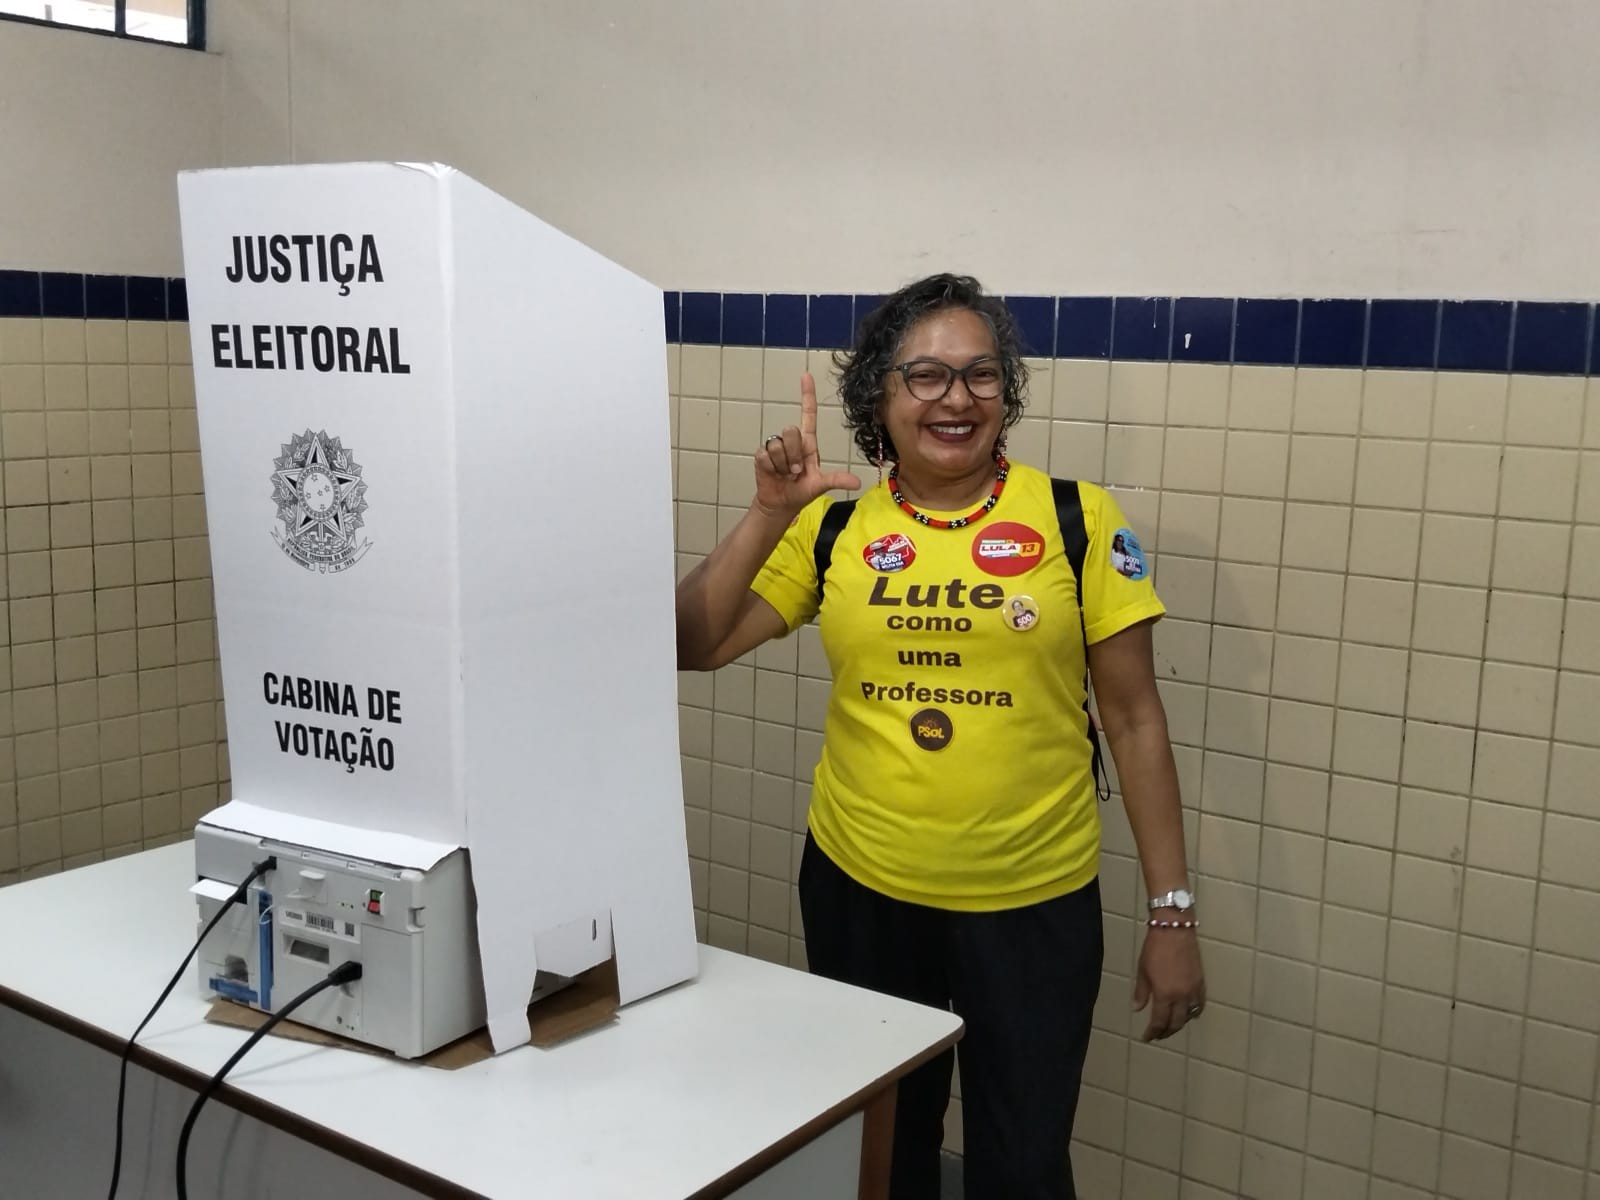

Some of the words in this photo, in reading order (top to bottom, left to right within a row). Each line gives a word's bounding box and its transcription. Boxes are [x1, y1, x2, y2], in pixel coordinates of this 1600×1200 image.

[225, 233, 384, 297] JUSTIÇA
[211, 324, 411, 374] ELEITORAL
[981, 544, 1017, 552] LULA
[1022, 543, 1035, 553] 13
[868, 576, 1003, 610] Lute
[887, 615, 973, 633] como
[897, 650, 963, 668] uma
[263, 671, 359, 718] CABINA
[367, 687, 402, 724] DE
[861, 681, 1014, 708] Professora
[275, 720, 395, 774] VOTAÇÃO
